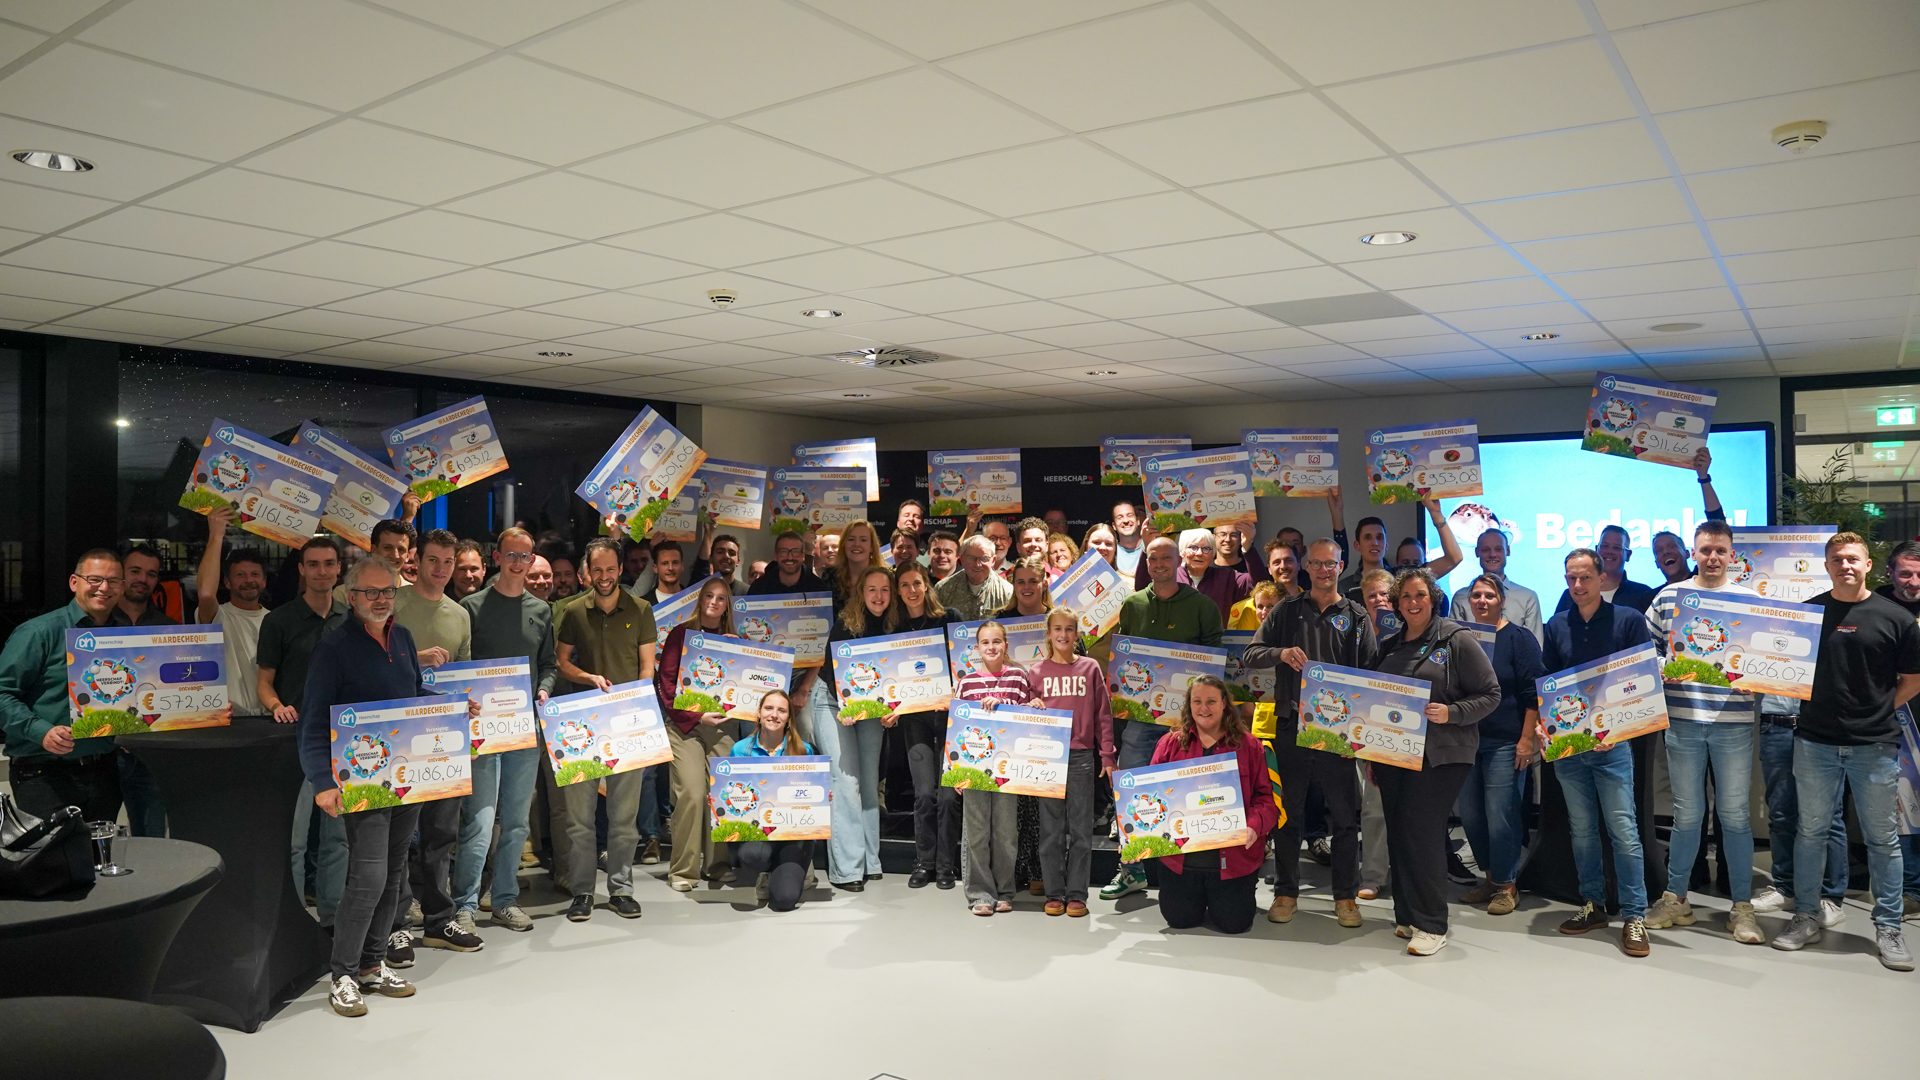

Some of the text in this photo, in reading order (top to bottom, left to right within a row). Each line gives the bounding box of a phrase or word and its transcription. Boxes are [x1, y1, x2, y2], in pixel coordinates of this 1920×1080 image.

[1656, 389, 1702, 402] WAARDECHEQUE
[1422, 427, 1464, 436] WAARDECHEQUE
[276, 453, 324, 476] WAARDECHEQUE
[1196, 454, 1237, 464] WAARDECHEQUE
[1749, 606, 1805, 620] WAARDECHEQUE
[151, 634, 207, 644] WAARDECHEQUE
[890, 637, 932, 648] WAARDECHEQUE
[741, 647, 782, 659] WAARDECHEQUE
[1170, 650, 1212, 662] WAARDECHEQUE
[1596, 654, 1641, 673] WAARDECHEQUE
[476, 666, 517, 676] WAARDECHEQUE
[1043, 676, 1086, 697] PARIS
[1367, 680, 1415, 694] WAARDECHEQUE
[598, 689, 642, 703] WAARDECHEQUE
[159, 692, 223, 714] 572,86
[405, 704, 454, 716] WAARDECHEQUE
[1012, 713, 1058, 724] WAARDECHEQUE
[1177, 763, 1223, 777] WAARDECHEQUE
